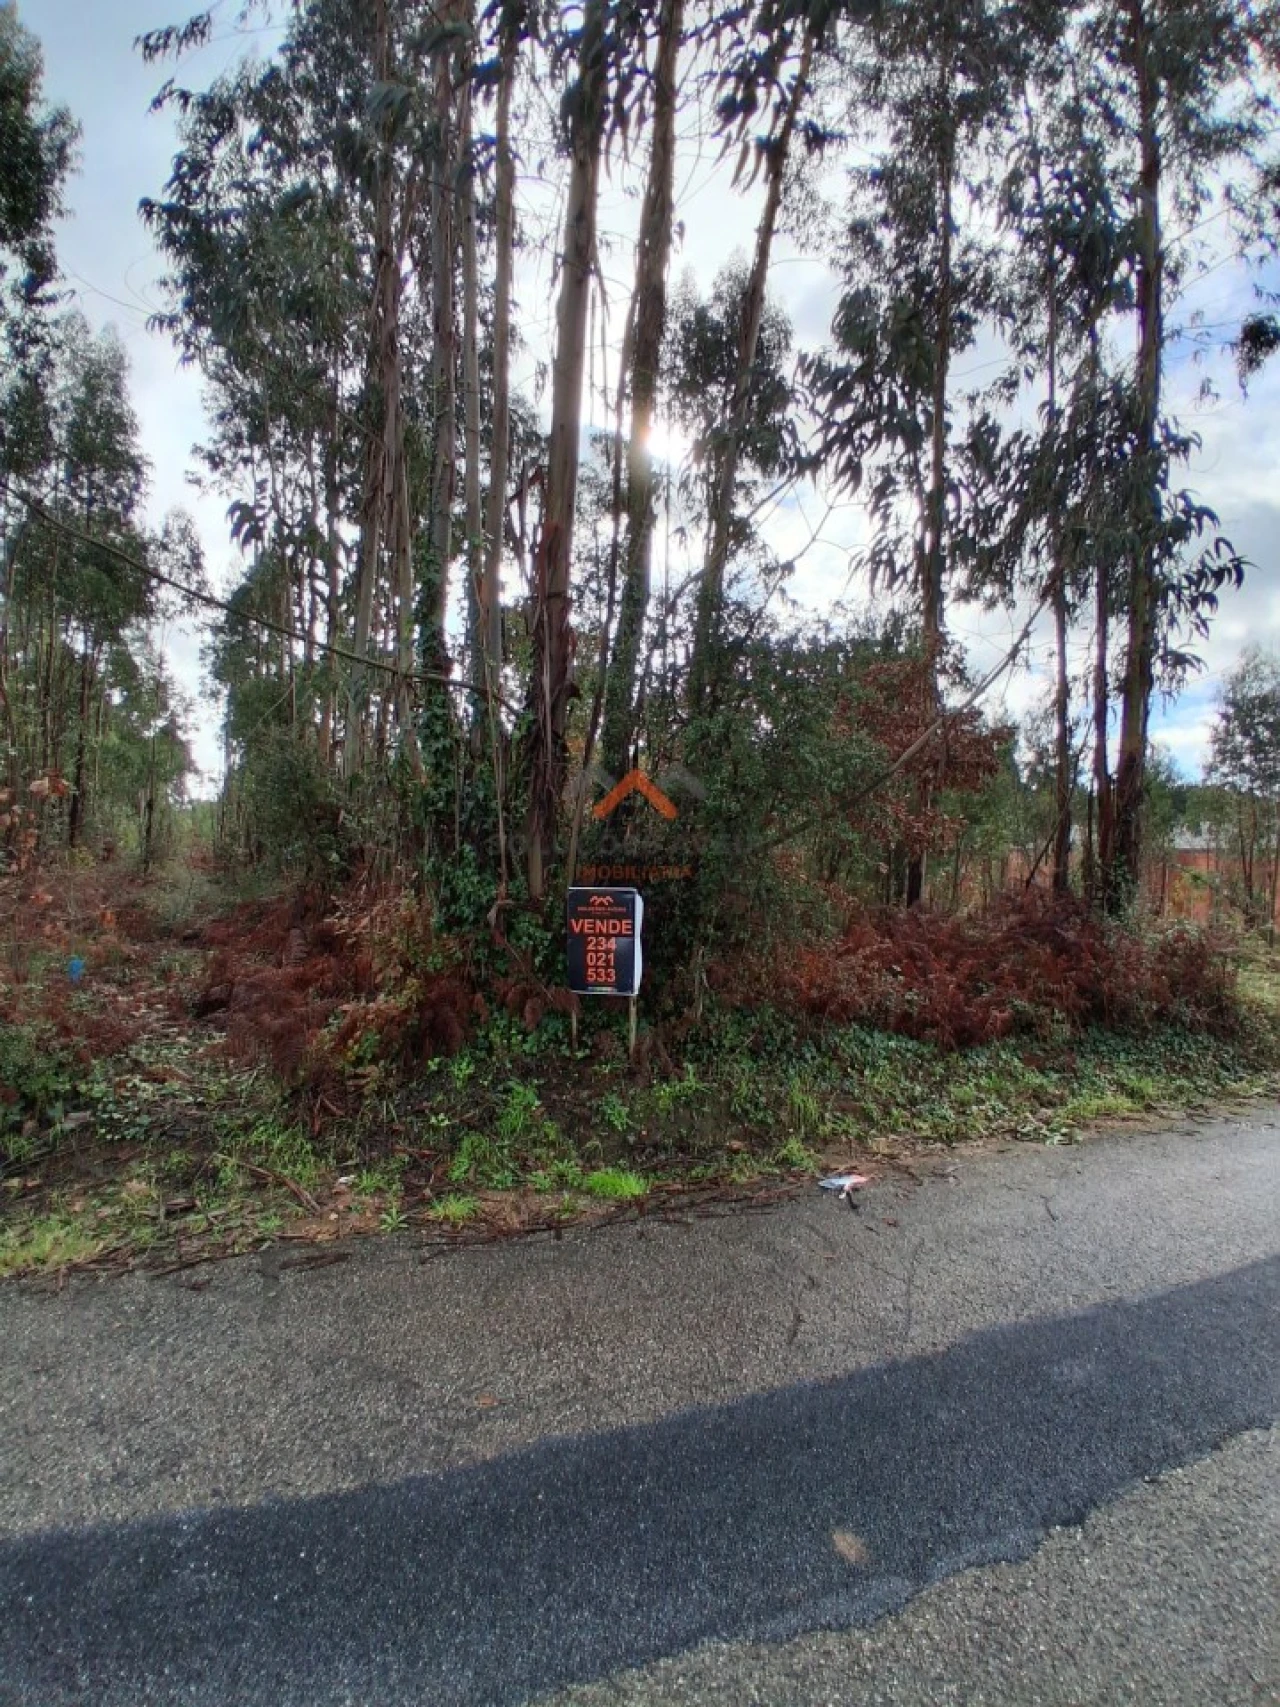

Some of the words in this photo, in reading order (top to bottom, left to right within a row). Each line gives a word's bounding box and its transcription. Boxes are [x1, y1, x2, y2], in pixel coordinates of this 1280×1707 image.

[570, 918, 633, 934] VENDE
[586, 936, 617, 950] 234
[586, 952, 615, 966] 021
[587, 968, 616, 982] 533
